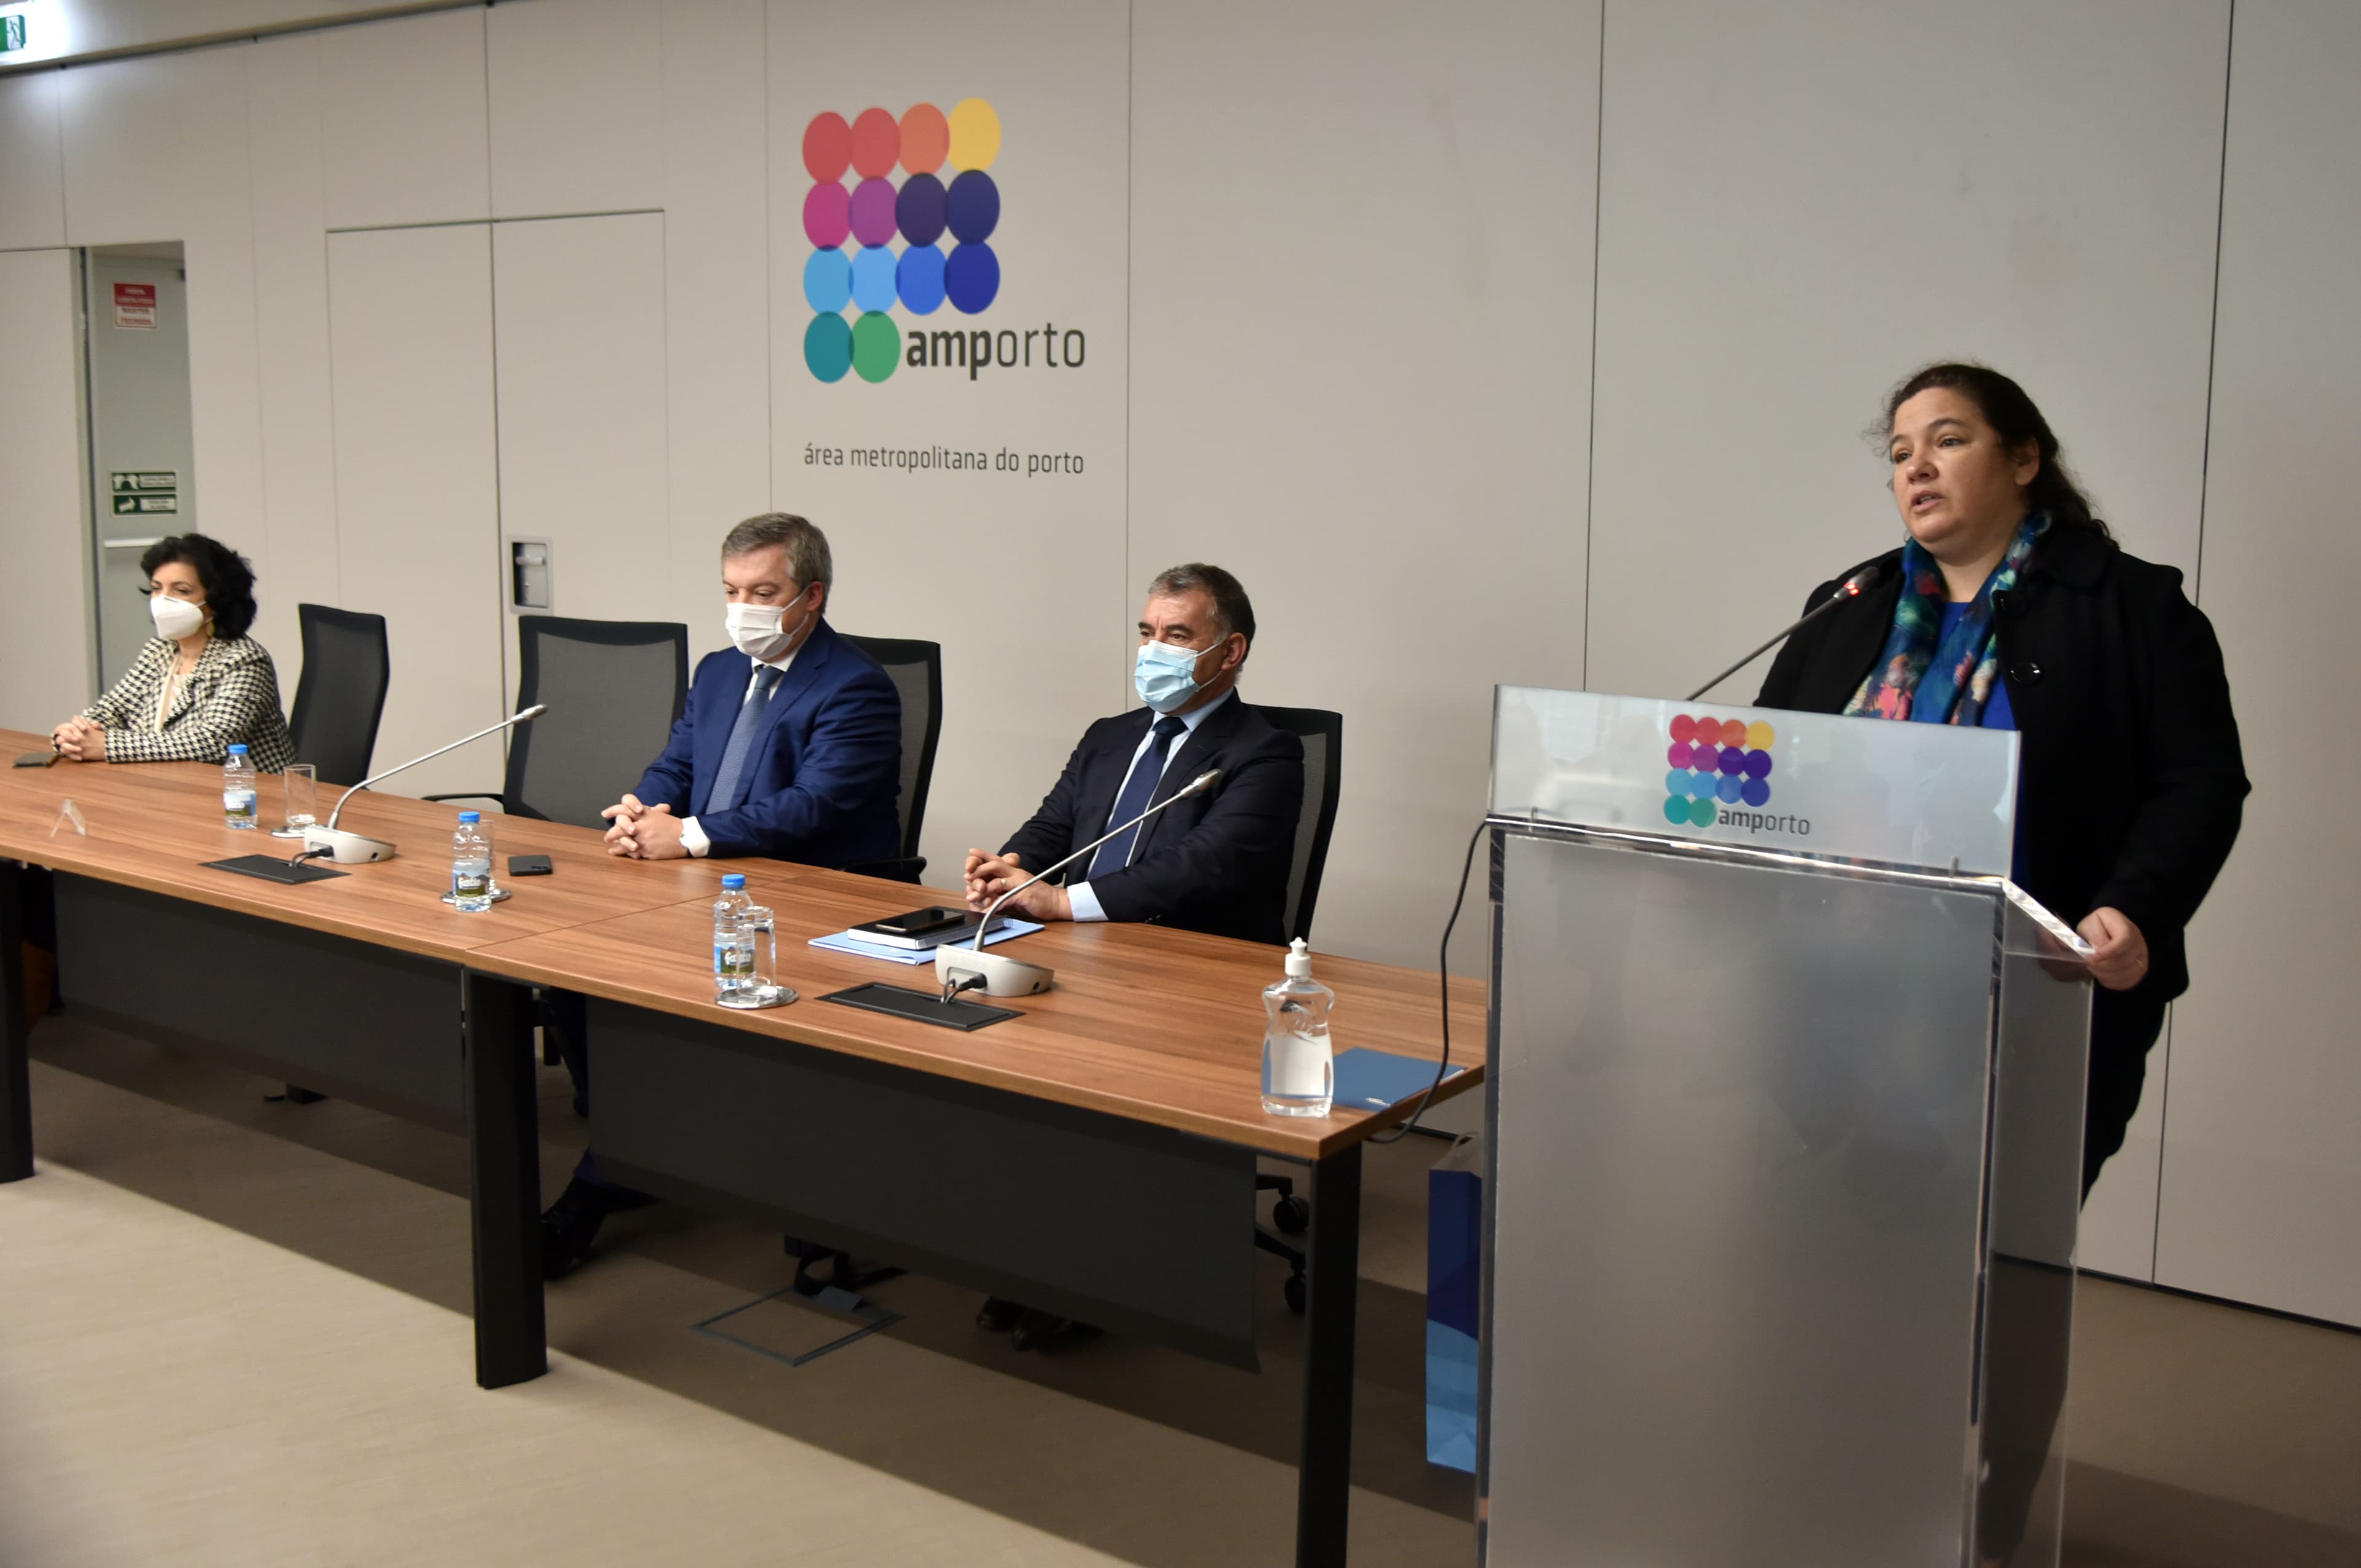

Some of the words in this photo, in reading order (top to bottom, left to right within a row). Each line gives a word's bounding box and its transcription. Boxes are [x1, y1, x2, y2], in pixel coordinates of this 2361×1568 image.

[906, 323, 1085, 380] amporto
[804, 442, 844, 465] área
[850, 444, 987, 474] metropolitana
[995, 447, 1019, 471] do
[1027, 452, 1084, 478] porto
[1718, 809, 1810, 835] amporto
